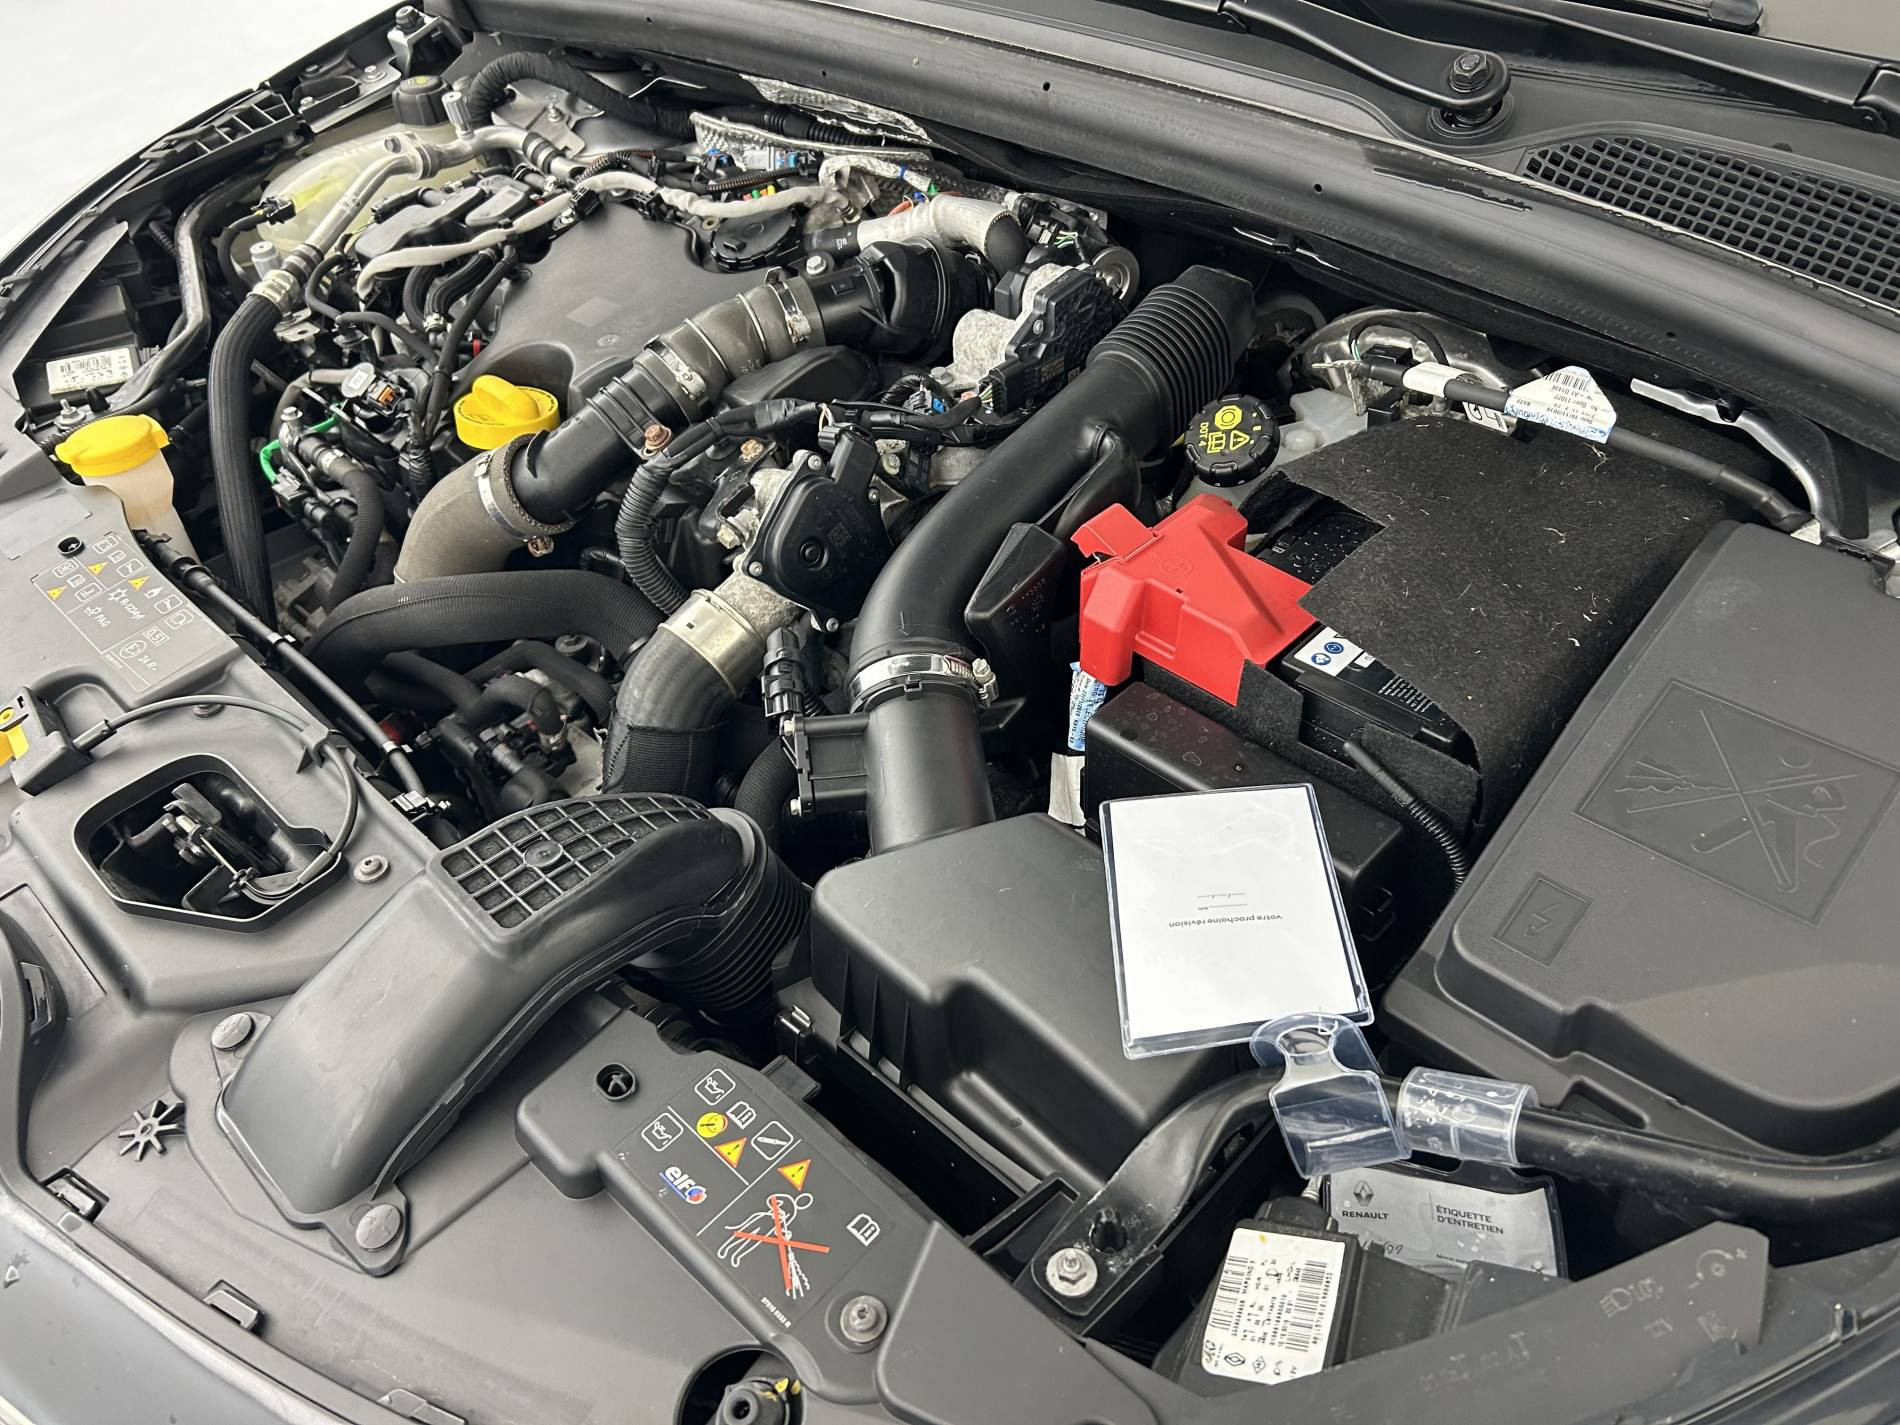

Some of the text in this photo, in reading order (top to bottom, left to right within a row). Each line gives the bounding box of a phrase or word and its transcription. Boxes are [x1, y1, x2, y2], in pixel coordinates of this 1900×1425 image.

[1199, 421, 1209, 439] DOT
[1168, 913, 1282, 928] votre prochaine révision
[1341, 1209, 1389, 1220] RENAULT
[1436, 1204, 1492, 1223] ÉTIQUETTE
[1437, 1215, 1504, 1235] D'ENTRETIEN
